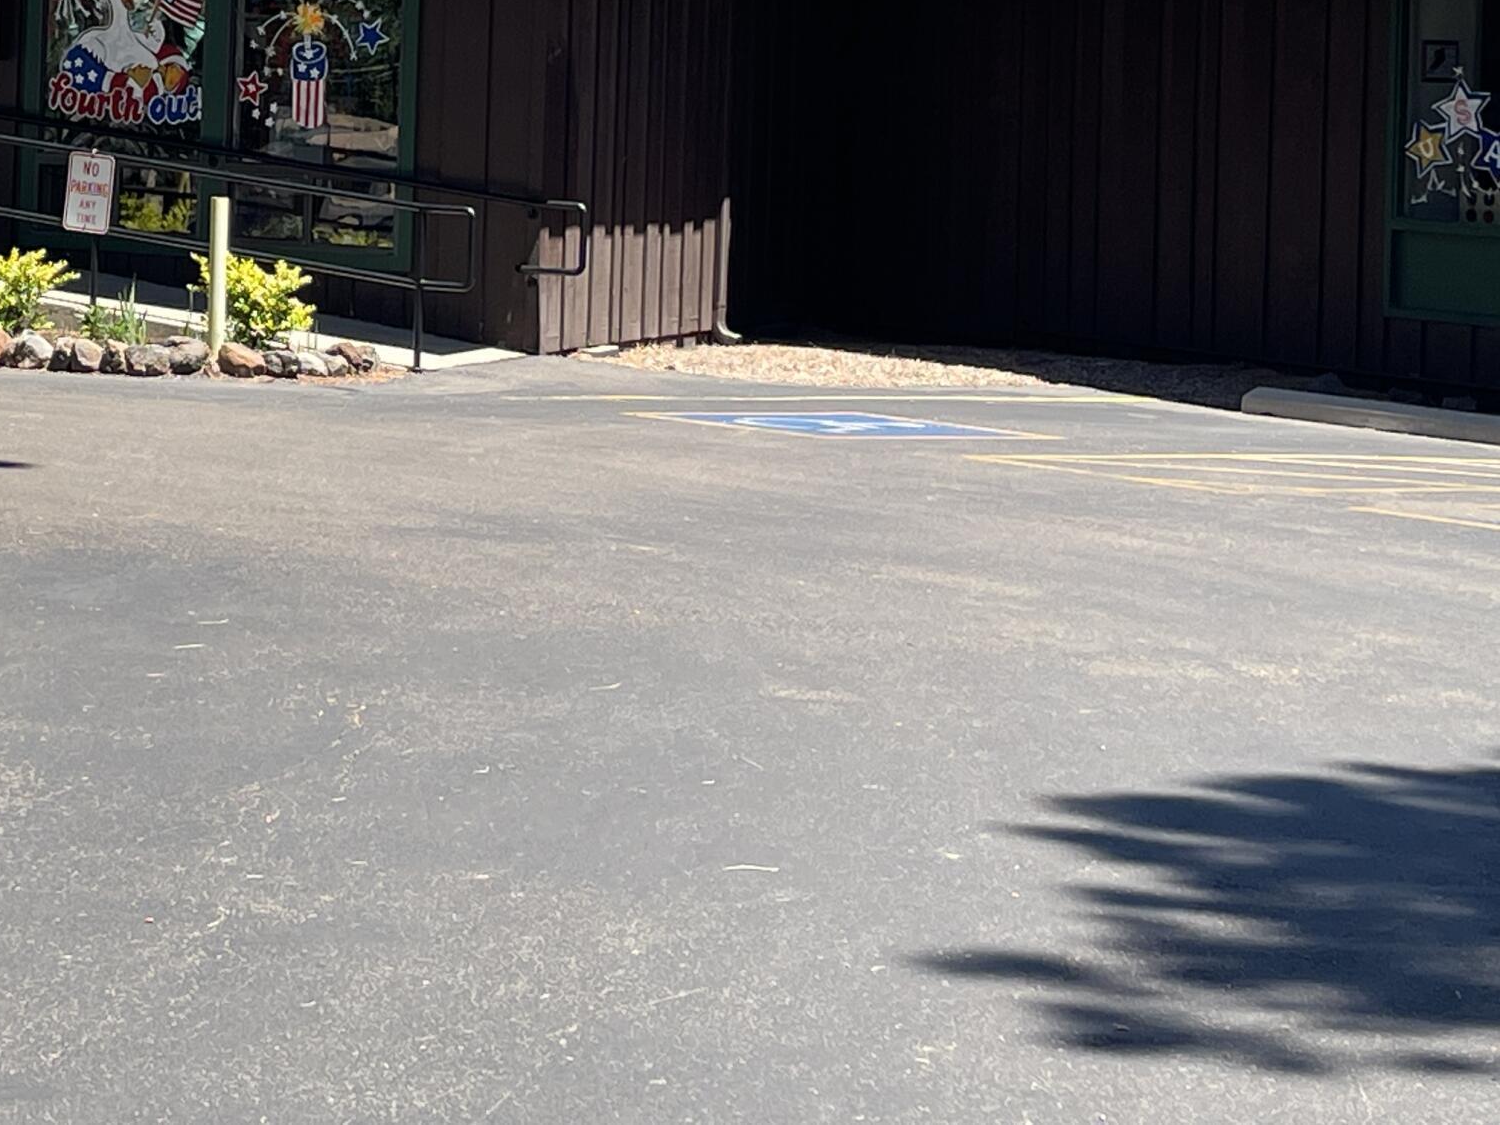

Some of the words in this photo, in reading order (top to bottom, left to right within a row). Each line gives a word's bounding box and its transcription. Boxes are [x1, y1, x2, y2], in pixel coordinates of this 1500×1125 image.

[48, 71, 144, 123] fourth
[83, 161, 100, 177] NO
[69, 179, 110, 197] PARKING
[79, 198, 97, 210] ANY
[76, 212, 97, 225] TIME
